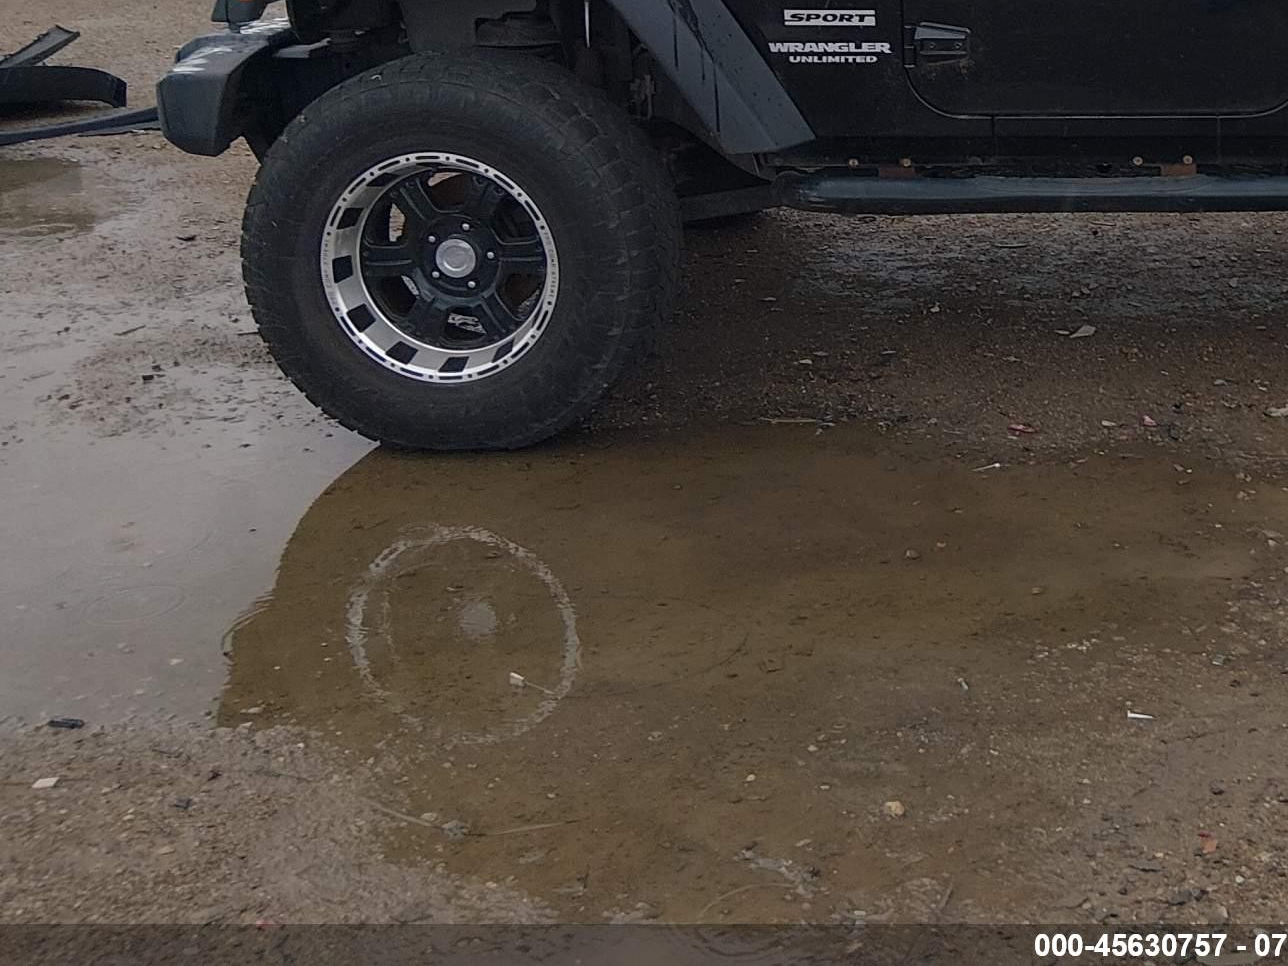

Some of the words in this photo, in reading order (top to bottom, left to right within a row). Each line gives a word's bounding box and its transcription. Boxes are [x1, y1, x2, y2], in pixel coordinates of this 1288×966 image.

[788, 12, 870, 24] SPORT
[768, 42, 892, 54] WRANGLER
[788, 55, 878, 63] UNLIMITED
